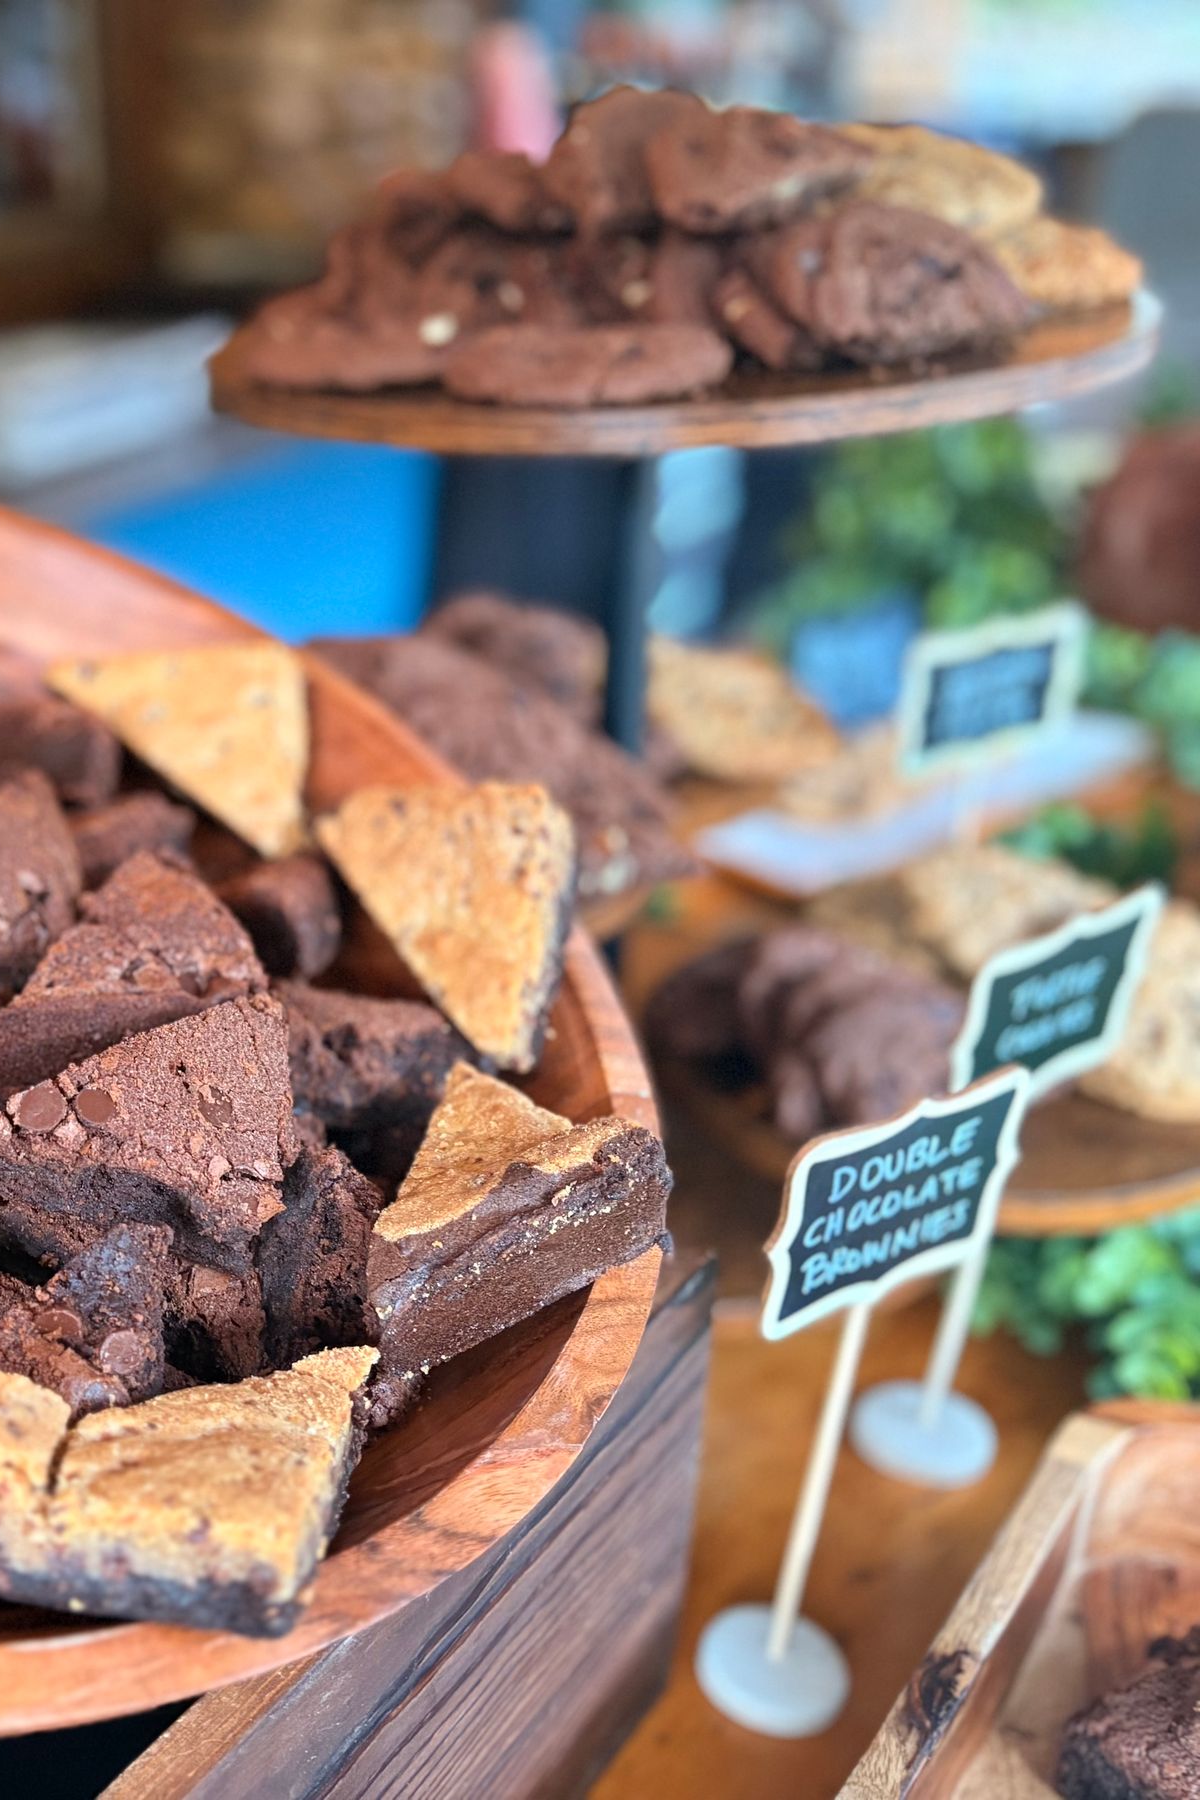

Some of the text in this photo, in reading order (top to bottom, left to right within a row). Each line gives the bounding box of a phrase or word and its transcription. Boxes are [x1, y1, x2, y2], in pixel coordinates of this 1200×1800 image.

[803, 1157, 983, 1248] CHOCOLATE
[828, 1117, 982, 1204] DOUBLE
[800, 1198, 970, 1295] BROWNIES
